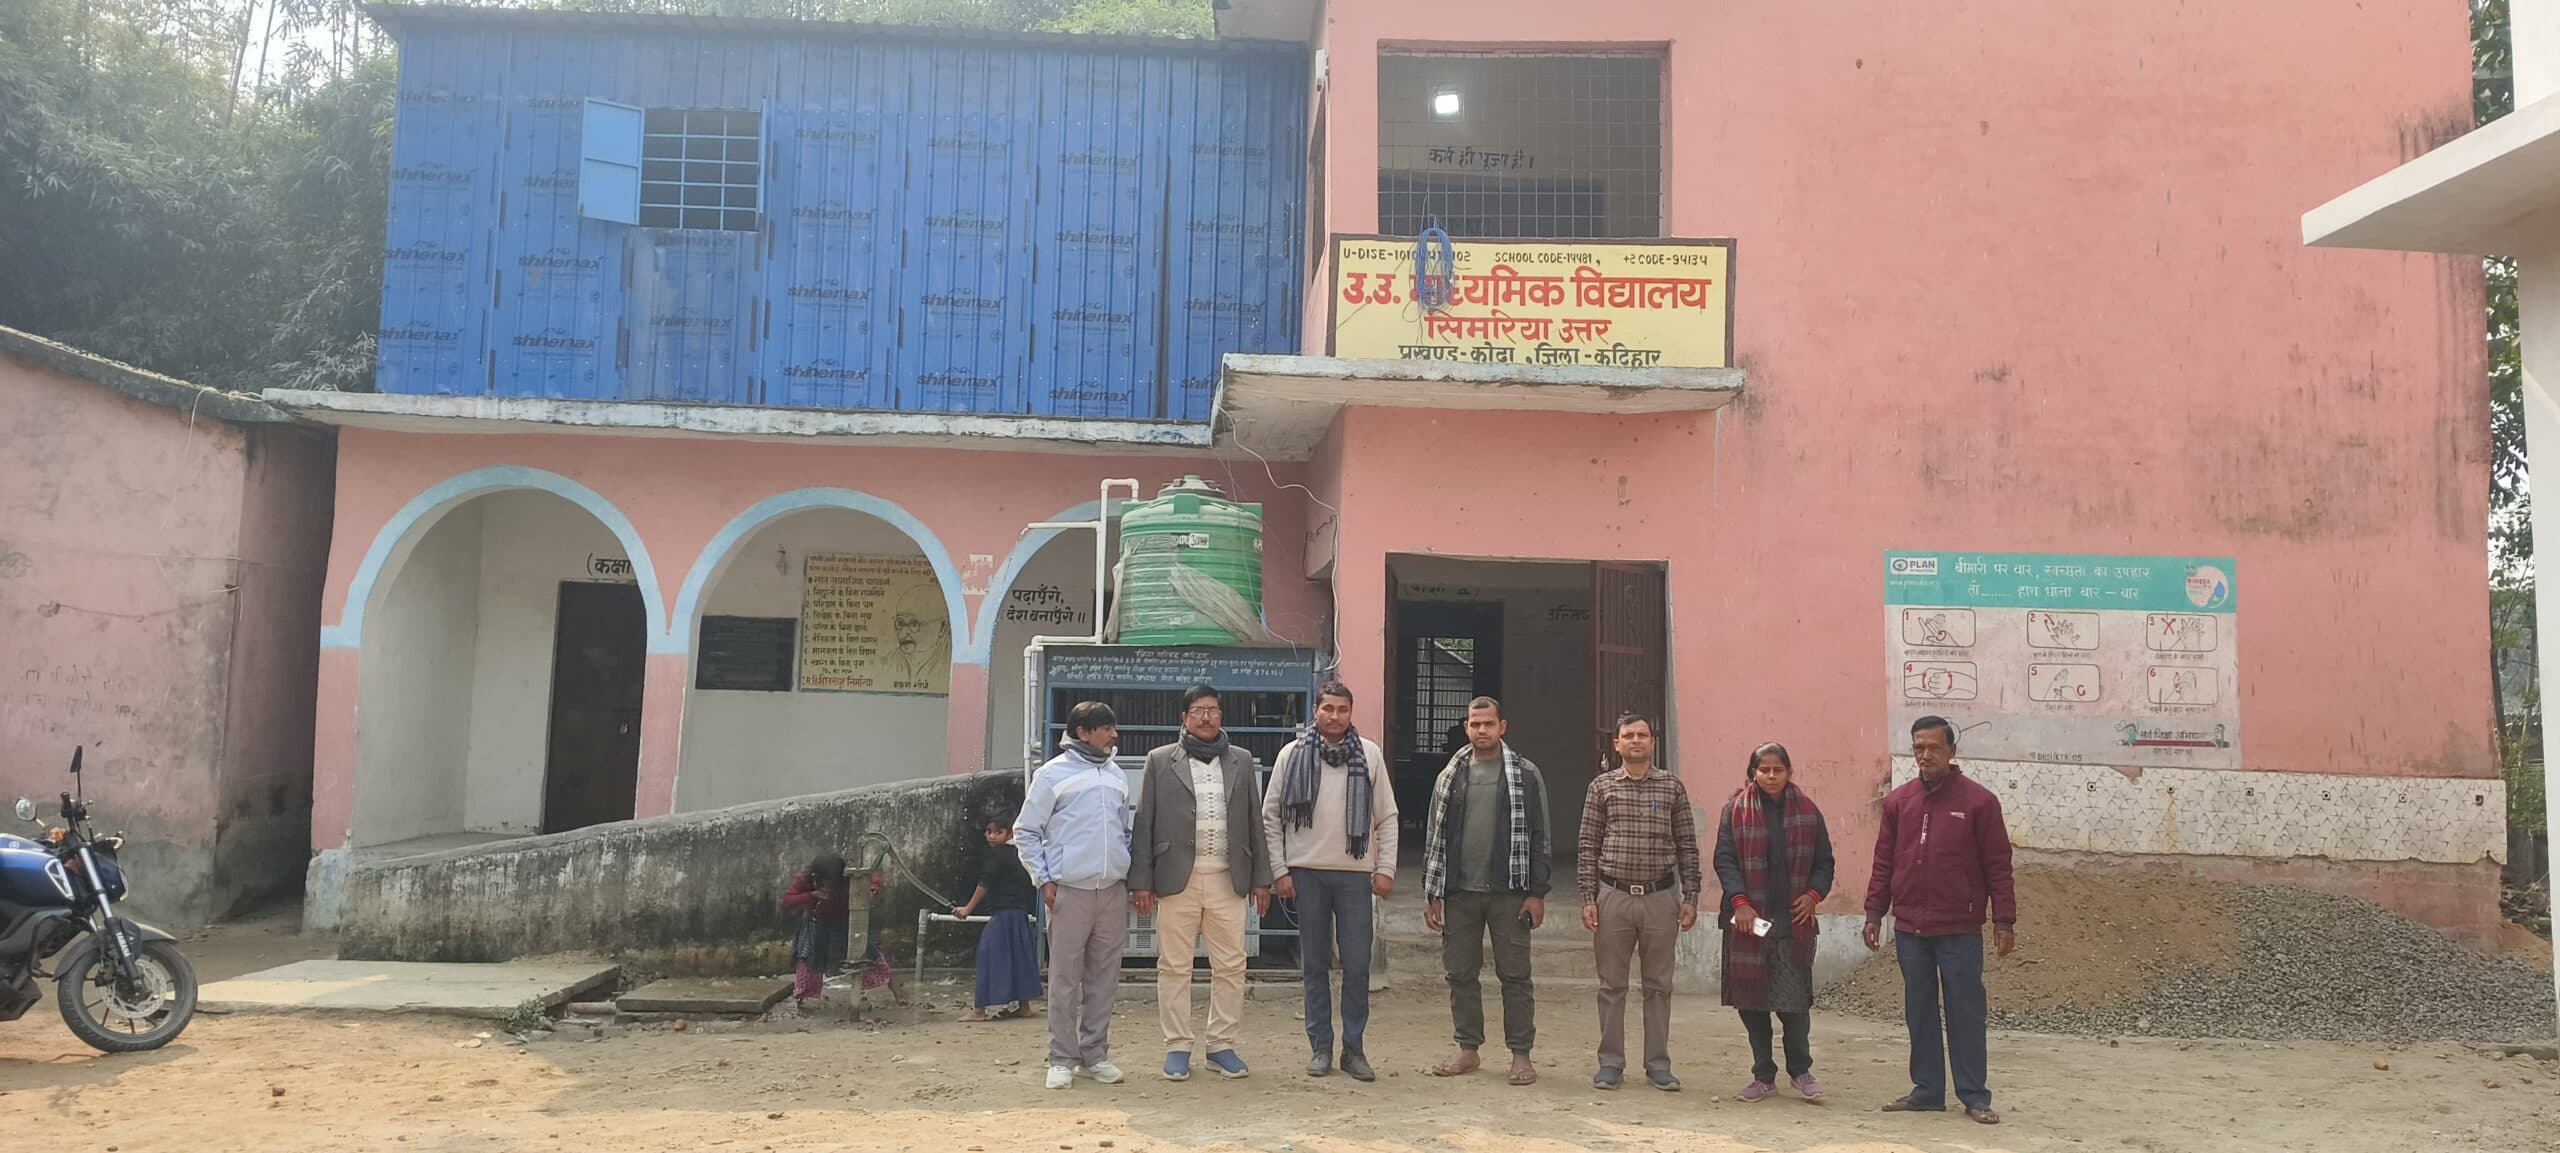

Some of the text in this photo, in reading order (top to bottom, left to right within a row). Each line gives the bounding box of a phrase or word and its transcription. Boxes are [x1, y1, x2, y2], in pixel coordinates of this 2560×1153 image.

[1495, 252, 1534, 264] SCHOOL
[1570, 265, 1712, 309] विद्यालय
[1424, 308, 1612, 344] सिमरिया उत्तर
[1910, 560, 1935, 569] PLAN
[1994, 563, 2008, 576] पर
[1905, 663, 1912, 672] 4
[2031, 666, 2037, 676] 5
[2149, 668, 2156, 677] 6
